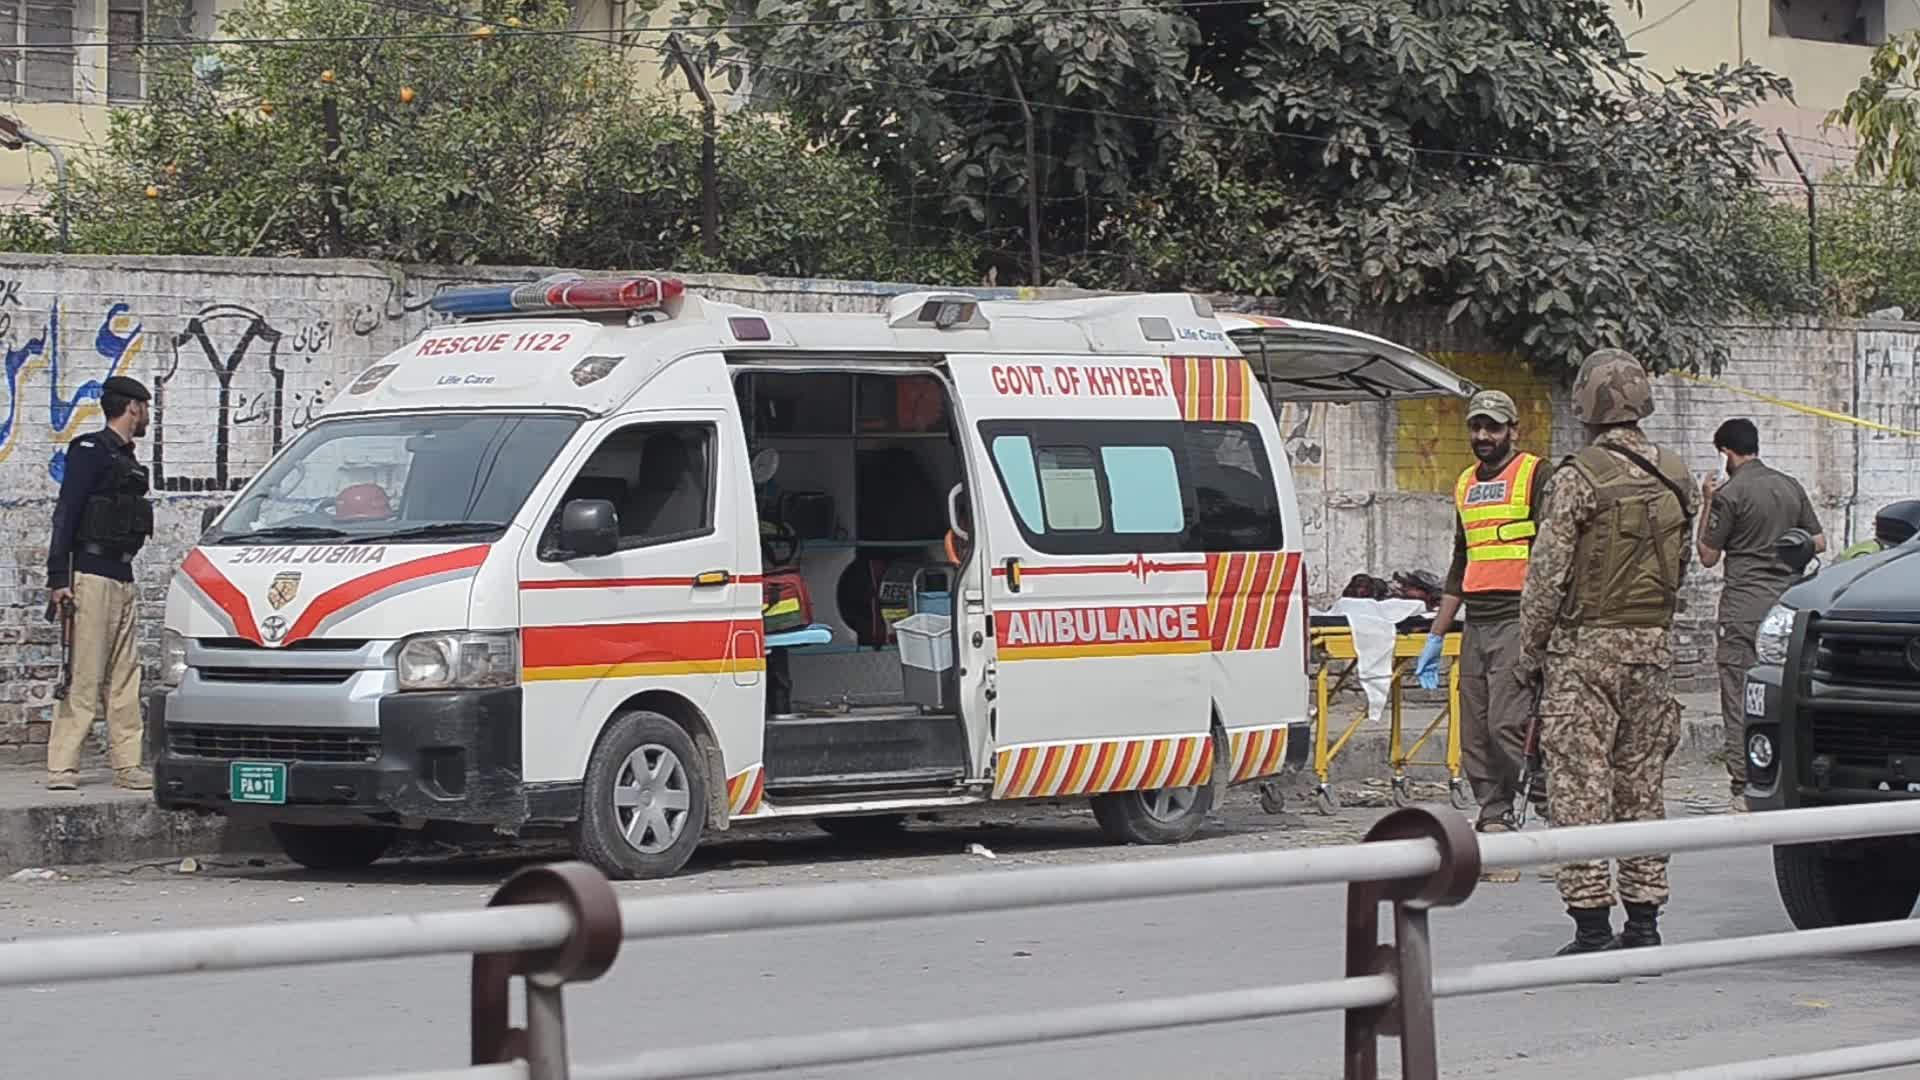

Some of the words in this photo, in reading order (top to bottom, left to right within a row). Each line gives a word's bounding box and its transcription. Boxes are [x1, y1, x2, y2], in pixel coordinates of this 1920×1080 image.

[416, 333, 510, 357] RESCUE
[513, 333, 571, 351] 1122
[1176, 328, 1199, 340] Life
[1199, 329, 1224, 341] Care
[437, 375, 461, 385] Life
[464, 374, 495, 384] Care
[991, 366, 1053, 395] GOVT.
[1055, 366, 1080, 395] OF
[1083, 366, 1168, 397] KHYBER
[1008, 607, 1198, 644] AMBULANCE
